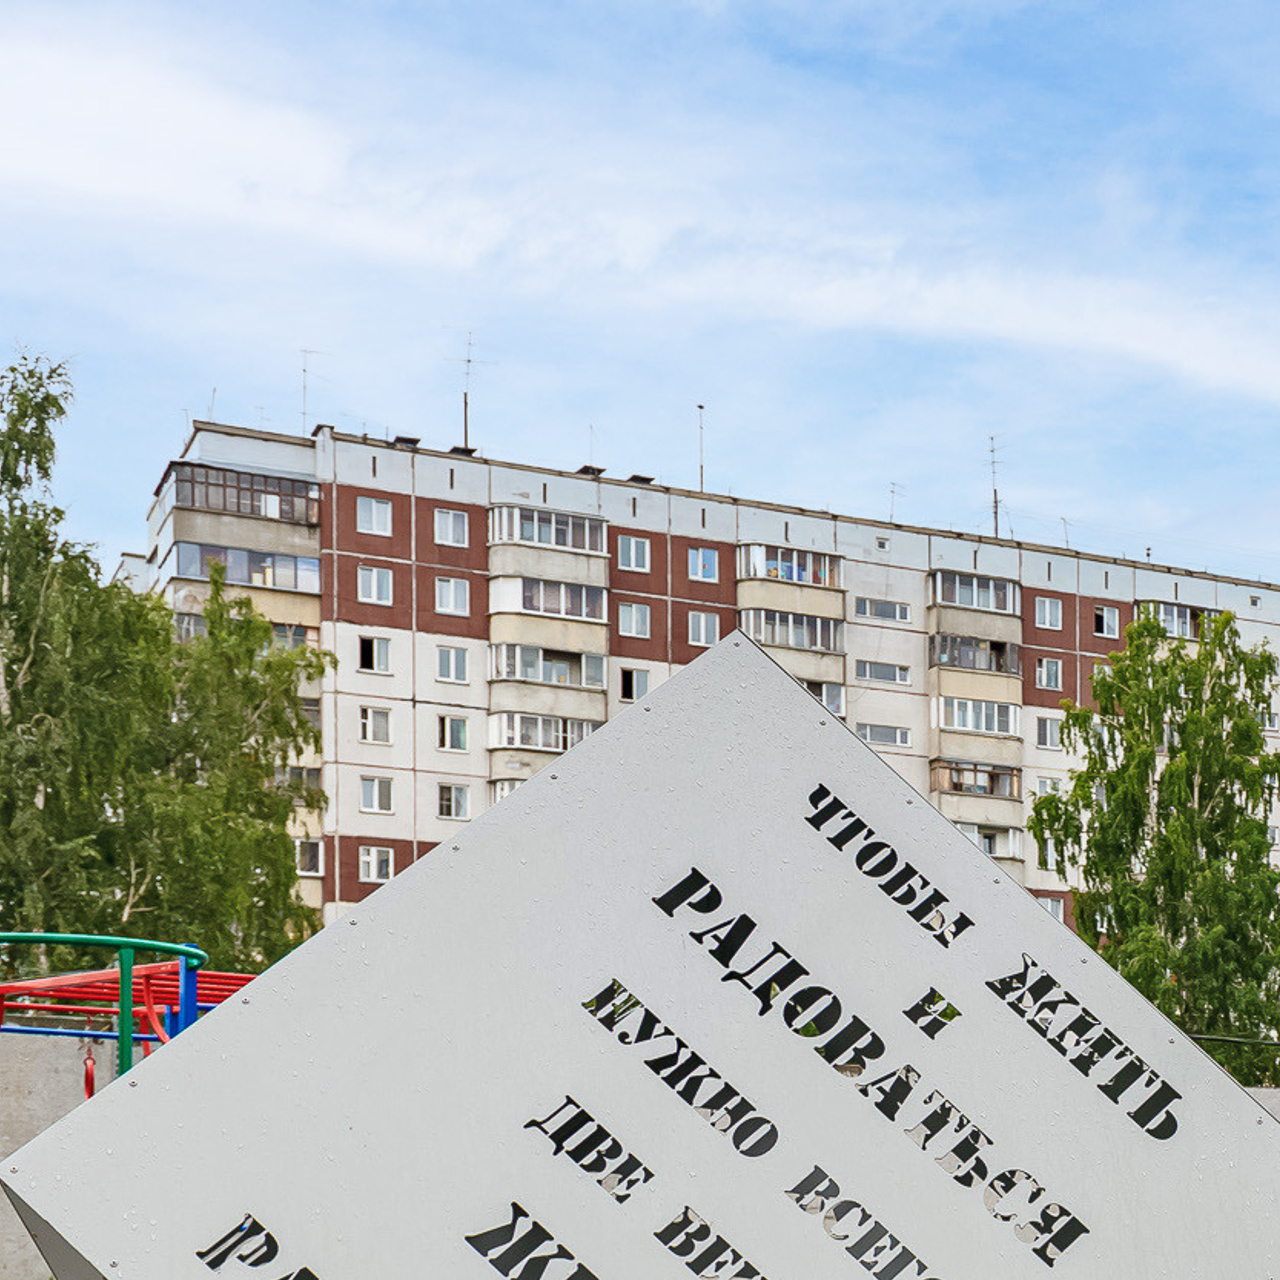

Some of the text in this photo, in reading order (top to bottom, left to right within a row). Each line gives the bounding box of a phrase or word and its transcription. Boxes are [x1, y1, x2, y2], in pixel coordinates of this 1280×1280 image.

[804, 783, 1183, 1141] ЧТОБЫ ЖИТЬ
[902, 986, 963, 1040] И
[523, 1095, 655, 1204] ДВЕ
[581, 978, 778, 1158] НУЖНО
[652, 867, 1091, 1268] РАДОВАТЬСЯ
